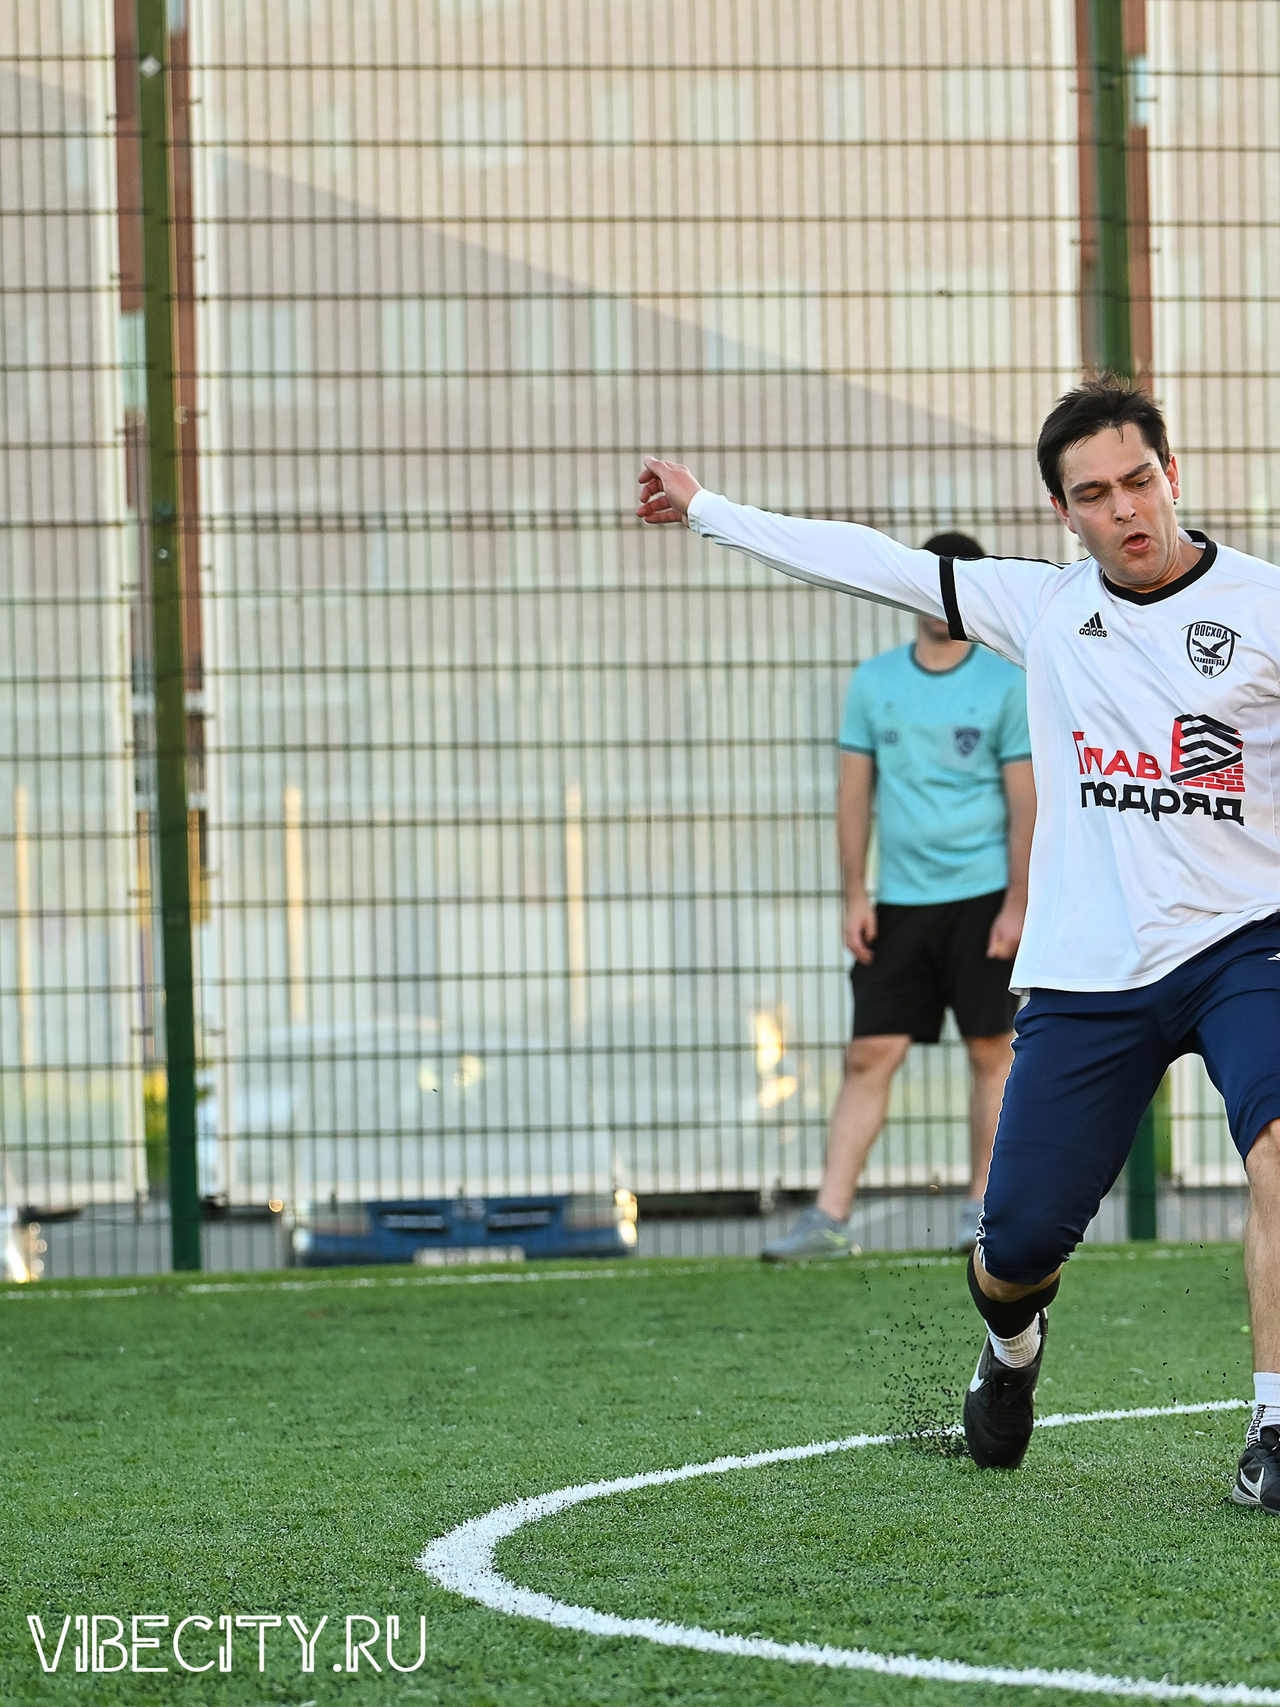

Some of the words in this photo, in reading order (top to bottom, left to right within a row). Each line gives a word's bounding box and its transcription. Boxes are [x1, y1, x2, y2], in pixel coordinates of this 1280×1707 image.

[1079, 627, 1107, 637] adidas
[1194, 624, 1228, 640] ВОСХОД
[1202, 664, 1214, 676] ФК
